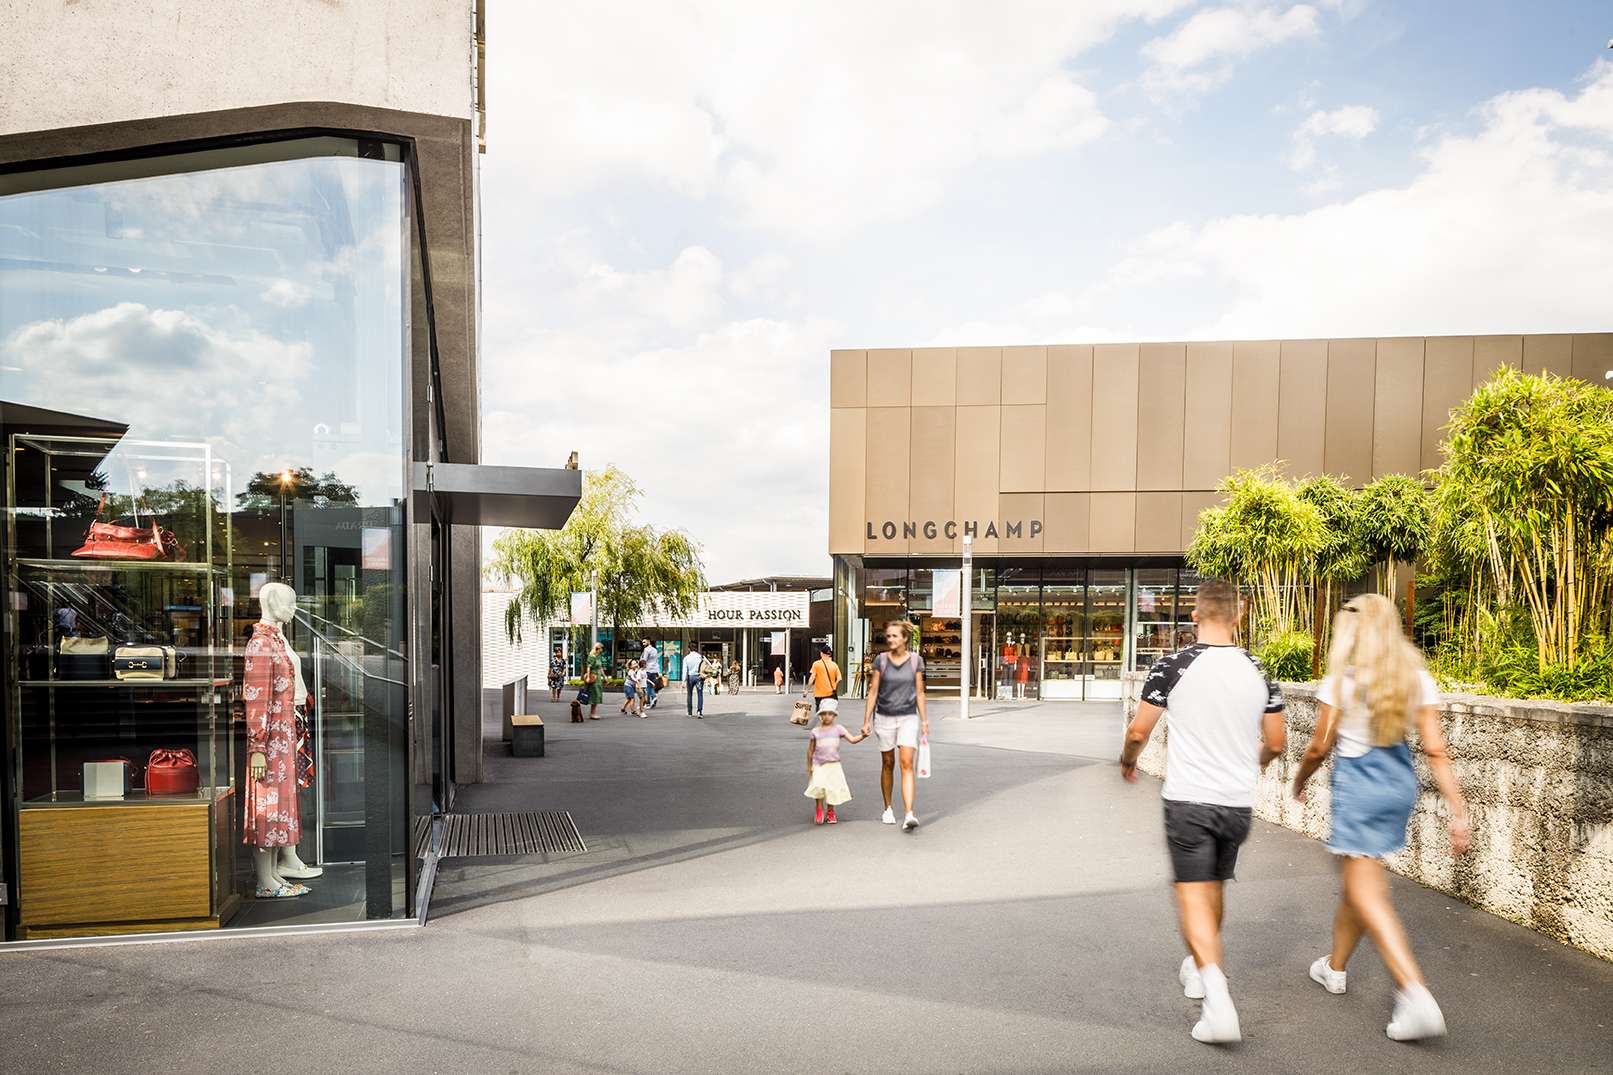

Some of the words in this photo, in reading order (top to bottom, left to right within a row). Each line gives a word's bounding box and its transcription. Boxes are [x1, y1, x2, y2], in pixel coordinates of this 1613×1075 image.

[866, 520, 1043, 540] LONGCHAMP
[708, 609, 744, 620] HOUR
[750, 609, 801, 620] PASSION
